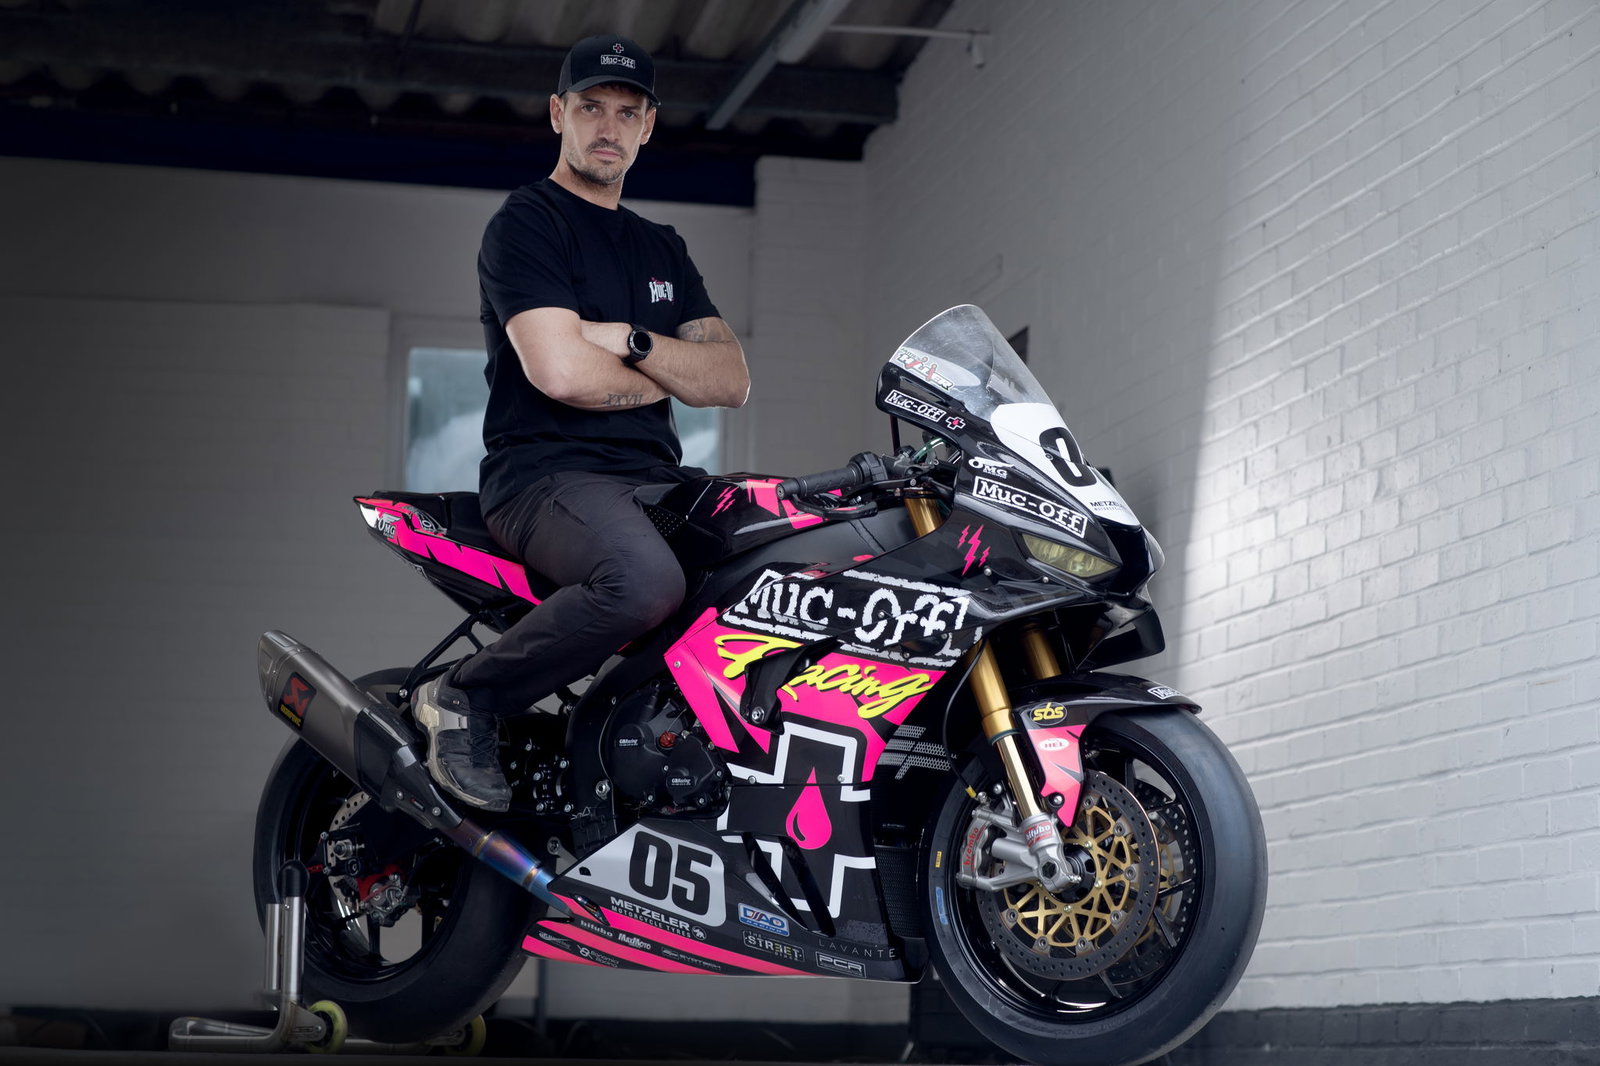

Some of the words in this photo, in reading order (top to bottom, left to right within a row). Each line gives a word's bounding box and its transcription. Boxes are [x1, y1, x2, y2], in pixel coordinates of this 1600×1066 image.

[889, 393, 940, 418] Muc-Off
[979, 480, 1082, 533] Muc-Off
[1033, 702, 1064, 720] sbs
[962, 827, 979, 866] brembo
[629, 831, 713, 916] 05
[610, 896, 690, 931] METZELER
[611, 905, 663, 929] MOTORCYCLE
[666, 926, 691, 939] TYRES
[580, 920, 613, 937] bitubo
[819, 939, 896, 958] LAVANTE
[819, 955, 862, 972] PCR
